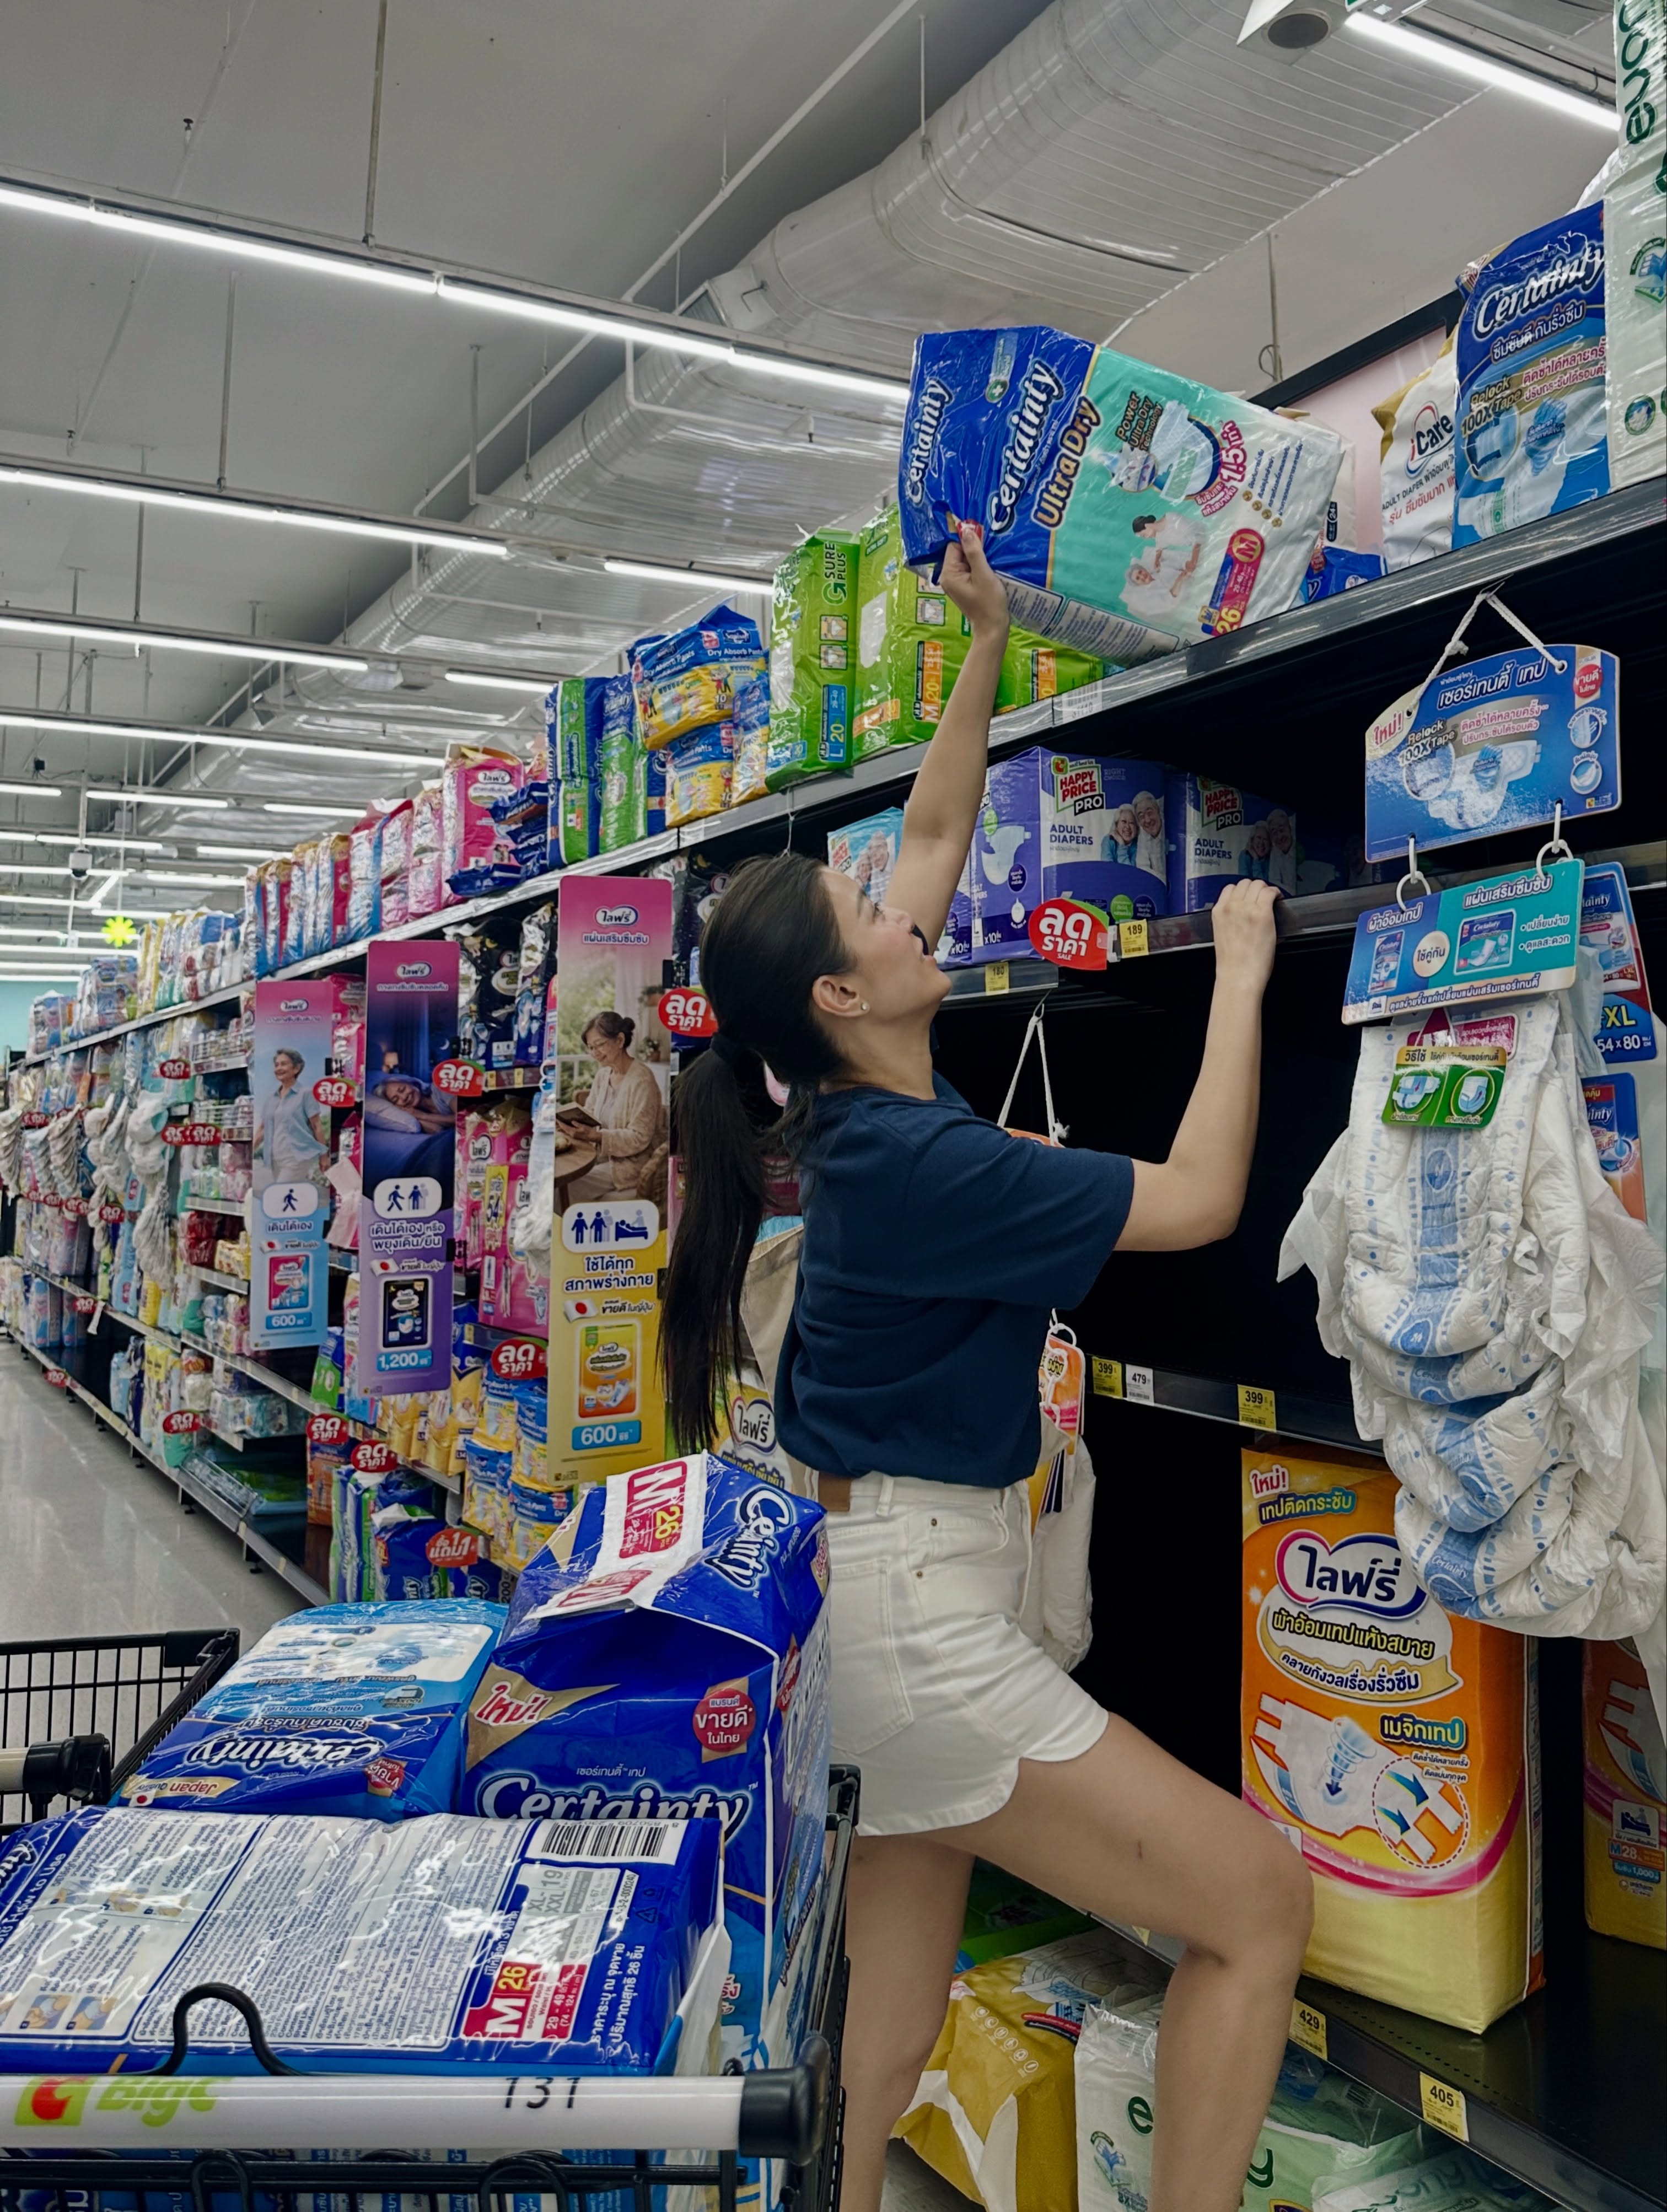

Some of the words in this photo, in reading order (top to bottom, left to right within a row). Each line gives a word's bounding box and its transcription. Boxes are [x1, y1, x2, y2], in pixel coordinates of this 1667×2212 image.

[1478, 244, 1605, 333] Certainty
[1494, 389, 1523, 418] Tape
[1116, 391, 1141, 441] Power
[1128, 417, 1145, 448] Ultra
[1141, 396, 1154, 418] Dry
[1139, 402, 1164, 452] Technology
[908, 378, 952, 504] Certainty
[990, 362, 1061, 531] Certainty
[1036, 456, 1079, 526] Ultra
[1062, 396, 1100, 454] Dry
[1382, 493, 1400, 511] ADULT
[1402, 478, 1423, 498] DIAPER
[1236, 536, 1259, 559] M
[825, 542, 836, 579] SURE
[837, 552, 846, 580] PLUS
[1216, 607, 1240, 634] 26
[707, 649, 722, 657] Dry
[643, 668, 655, 677] Dry
[926, 682, 940, 701] 20
[1438, 662, 1515, 709] เซอร์เทนตี้
[1517, 661, 1545, 687] เทป
[715, 694, 727, 703] 10
[924, 703, 939, 720] M
[830, 723, 845, 743] 20
[1373, 715, 1403, 745] ใหม่!
[1407, 720, 1444, 746] Relock
[1430, 729, 1456, 749] Tape
[830, 748, 843, 757] L
[1060, 771, 1094, 790] HAPPY
[1062, 781, 1097, 803] PRICE
[1075, 795, 1103, 814] PRO
[1207, 798, 1238, 817] PRICE
[1050, 824, 1084, 834] ADULT
[1218, 812, 1241, 828] PRO
[1050, 834, 1094, 845] DIAPERS
[1195, 838, 1225, 849] ADULT
[1195, 848, 1232, 859] DIAPERS
[1464, 876, 1552, 908] แผ่นเสริมซึมซับ
[1039, 908, 1093, 941] ลด
[1367, 903, 1422, 933] ผ้าอ้อมเทป
[1527, 914, 1569, 932] เปลี่ยนง่าย
[985, 933, 997, 945] x10
[1127, 924, 1143, 936] 189
[1041, 936, 1087, 956] ราคา
[1526, 935, 1570, 953] ดูแลสะดวก
[1416, 947, 1445, 966] ใช้คู่กัน
[665, 994, 707, 1018] ลด
[668, 1014, 702, 1028] ราคา
[1597, 1037, 1614, 1053] 54
[1623, 1035, 1641, 1050] 80
[439, 1063, 475, 1080] ลด
[317, 1081, 347, 1095] ลด
[440, 1079, 470, 1090] ราคา
[319, 1093, 346, 1102] ราคา
[370, 1221, 423, 1237] เดินได้เอง
[425, 1220, 445, 1234] หรือ
[373, 1235, 442, 1254] พยุงเดิน/ยืน
[585, 1256, 634, 1272] ใช้ได้ทุก
[564, 1273, 653, 1292] สภาพร่างกาย
[272, 1316, 296, 1326] 600
[378, 1353, 418, 1369] 1,200
[497, 1343, 536, 1362] ลด
[500, 1360, 533, 1374] ราคา
[1098, 1361, 1114, 1375] 399
[1131, 1373, 1147, 1385] 479
[1244, 1390, 1263, 1404] 399
[310, 1417, 340, 1431] ลด
[738, 1404, 771, 1443] ไลฟ์รี่
[313, 1429, 337, 1439] ราคา
[580, 1427, 617, 1446] 600
[356, 1444, 387, 1460] ลด
[359, 1456, 386, 1467] ราคา
[1251, 1468, 1287, 1494] ใหม่!
[1260, 1492, 1353, 1521] เทปติดกระชับ
[654, 1505, 681, 1539] 26
[1298, 1544, 1402, 1602] ไลฟ์รี่
[1273, 1608, 1434, 1659] ผ้าอ้อมเทปแห้งสบาย
[1281, 1653, 1420, 1693] คลายกังวลเรื่องรั่วซึม
[474, 1681, 551, 1725] ใหม่!
[710, 1694, 739, 1708] แบรนด์
[707, 1731, 740, 1745] ในไทย
[1384, 1714, 1460, 1743] เมจิกเทป
[191, 1737, 381, 1770] Certainty
[576, 1764, 622, 1777] เซอร์เทนตี้
[628, 1766, 646, 1777] เทป
[169, 1781, 217, 1796] Japan
[481, 1776, 751, 1842] Certainty
[1610, 1842, 1622, 1857] M
[1622, 1846, 1637, 1860] 28
[543, 1869, 564, 1888] 19
[2, 1896, 36, 1924] How
[30, 1878, 47, 1893] to
[42, 1853, 67, 1877] Use
[544, 1890, 566, 1913] XXL
[626, 1942, 646, 1961] ชิ้น
[627, 1961, 641, 1975] 26
[498, 1967, 527, 1991] 26
[553, 1993, 564, 2006] 49
[590, 1992, 616, 2044] ราคาระบุ
[607, 1942, 630, 1978] จุดขาย
[485, 1997, 526, 2034] M
[607, 1974, 641, 2044] ปริมาณสุทธิ
[547, 2015, 560, 2031] 29
[1299, 2009, 1320, 2030] 429
[505, 2076, 581, 2109] 131
[1429, 2085, 1454, 2108] 405
